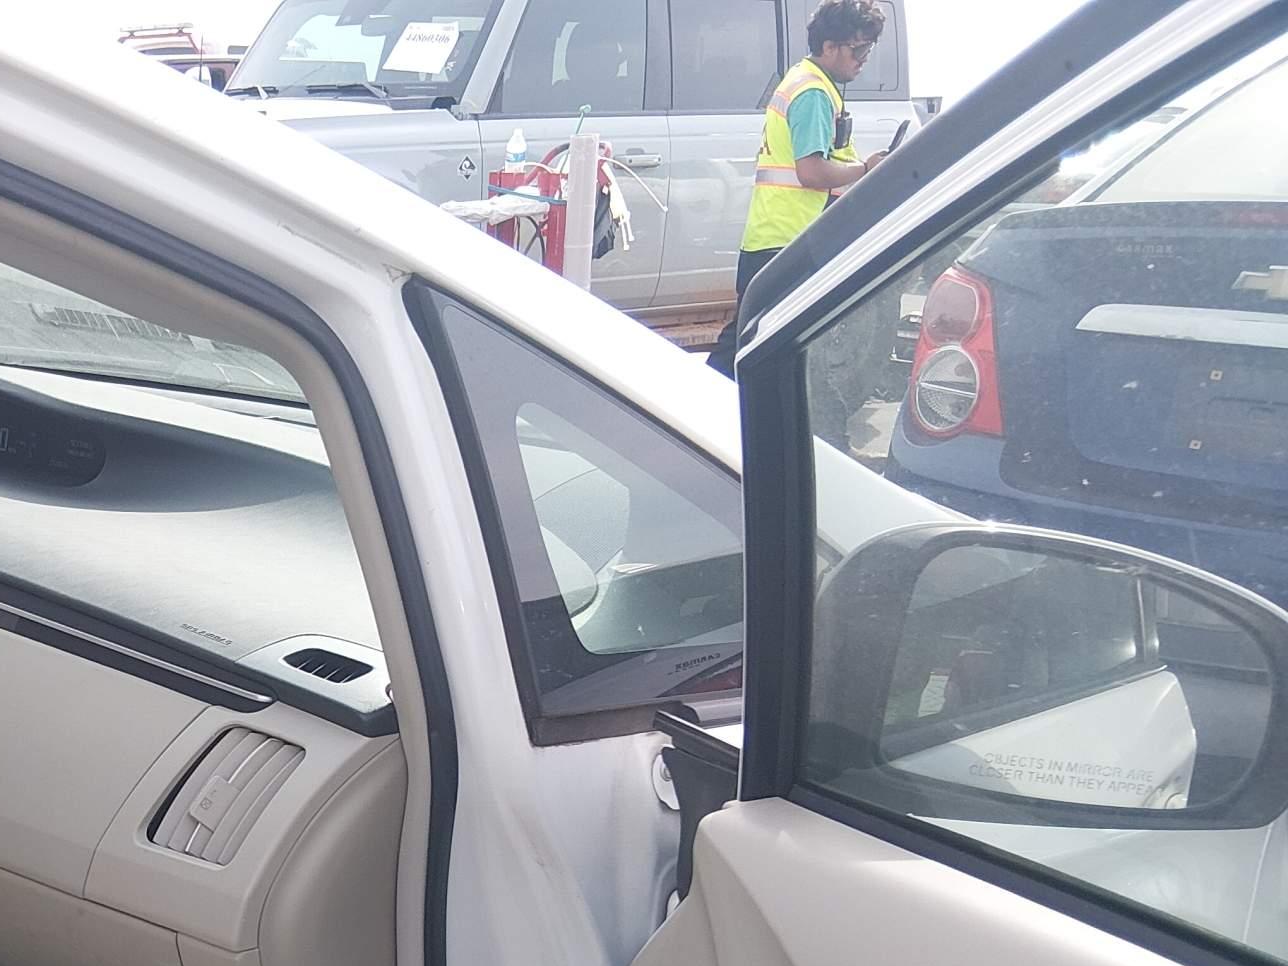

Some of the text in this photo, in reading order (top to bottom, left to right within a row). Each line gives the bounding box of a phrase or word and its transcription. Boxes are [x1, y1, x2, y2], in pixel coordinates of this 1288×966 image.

[968, 763, 1024, 780] CLOSER
[1030, 771, 1065, 786] THAN
[1069, 776, 1104, 791] THEY
[983, 752, 1155, 783] OBJECTS IN MIRROR ARE
